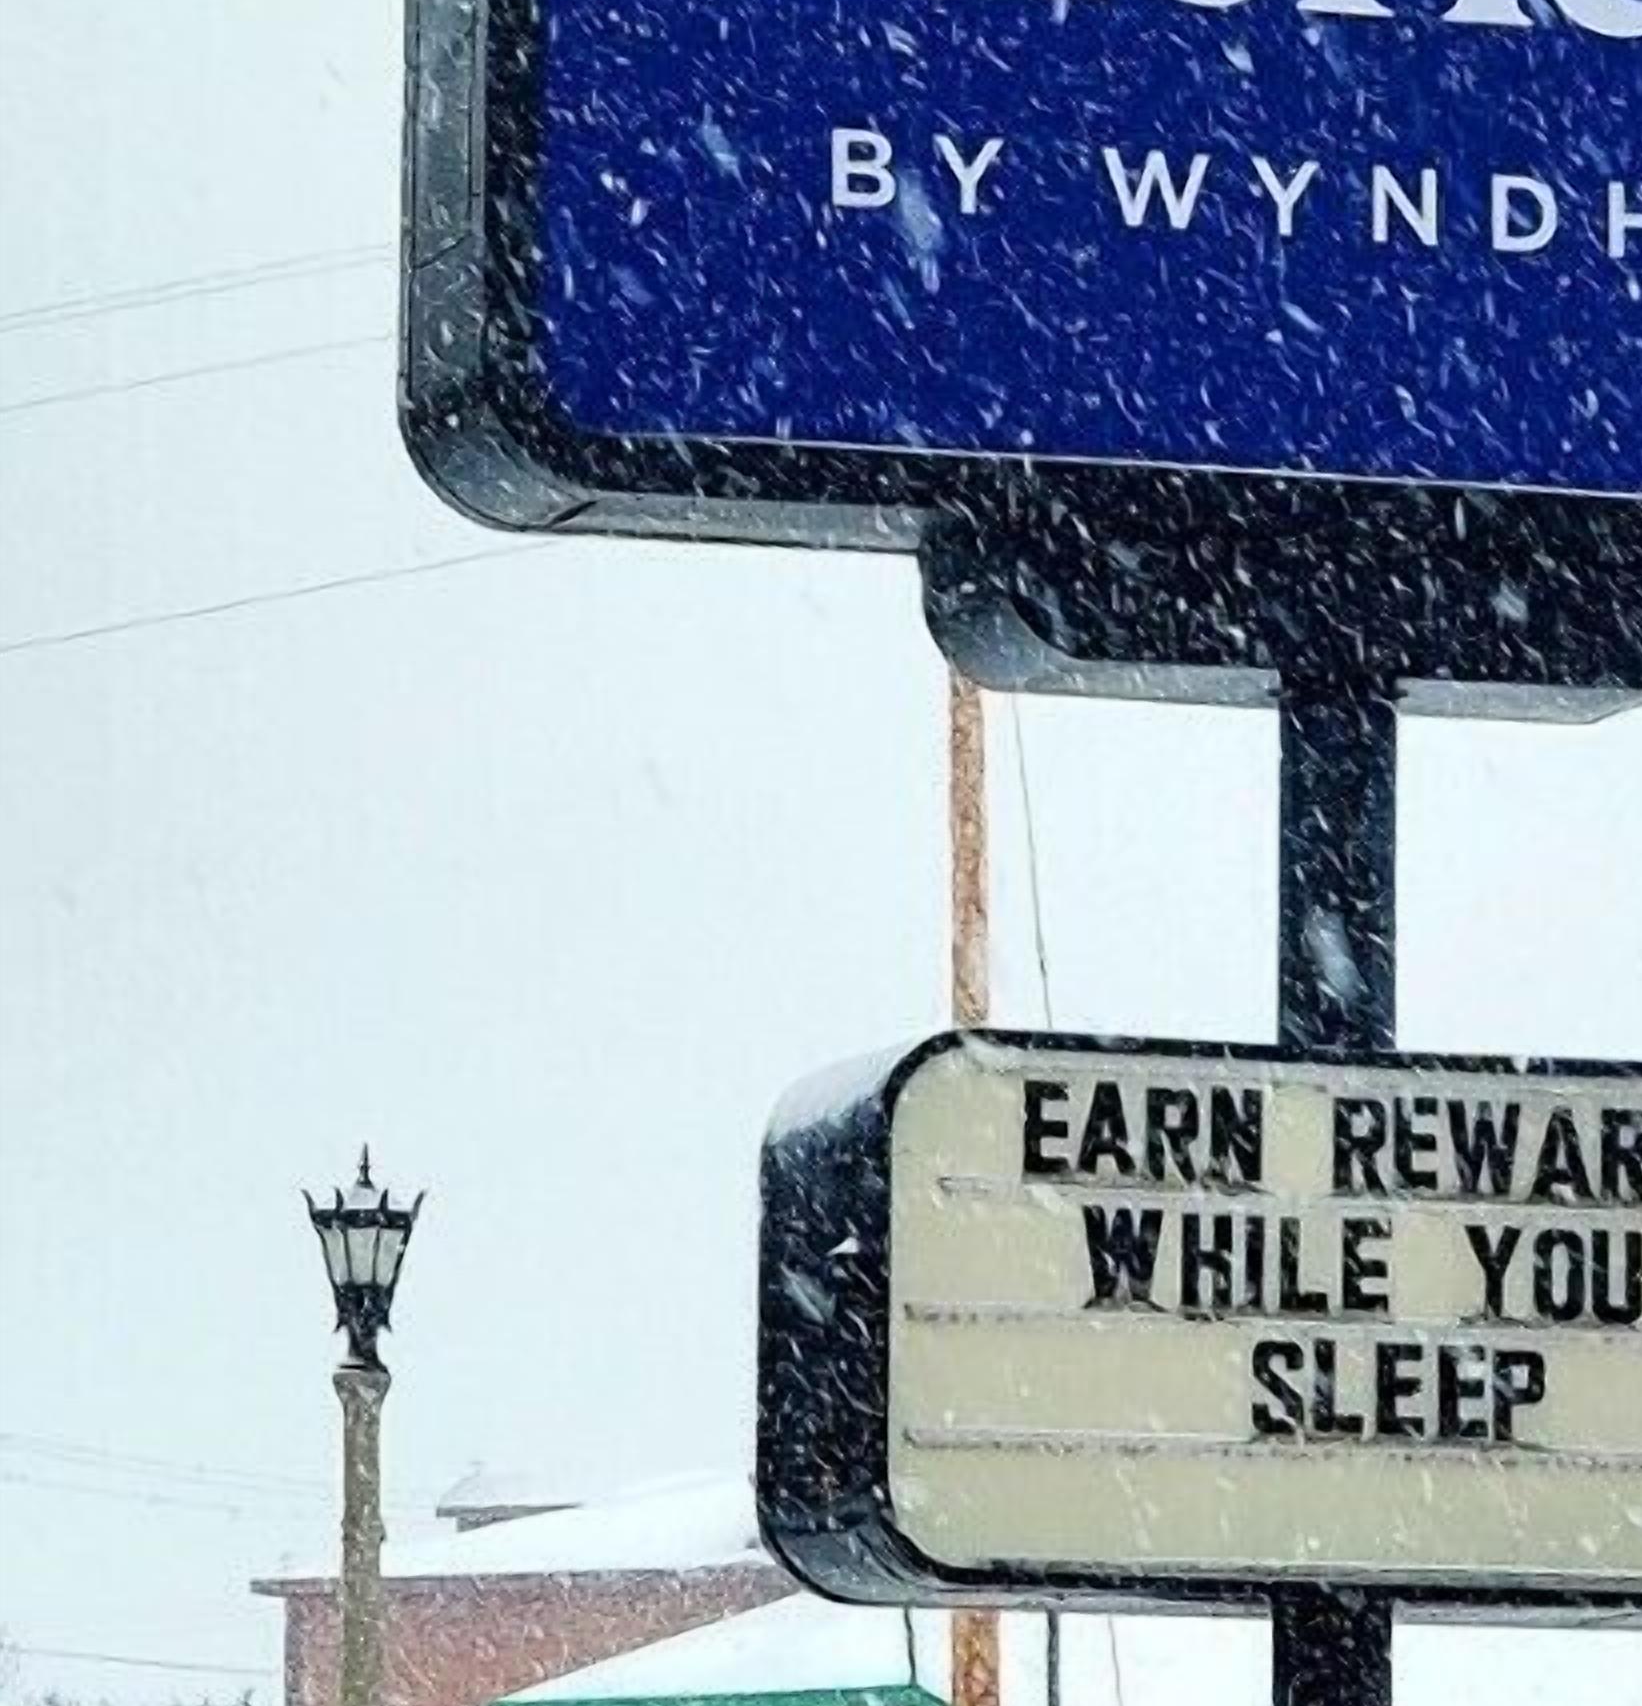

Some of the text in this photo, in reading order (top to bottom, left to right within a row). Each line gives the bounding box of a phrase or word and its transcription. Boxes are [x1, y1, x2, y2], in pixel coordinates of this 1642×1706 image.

[833, 129, 1003, 214] BY
[1023, 1080, 1263, 1186] EARN
[1082, 1205, 1393, 1312] WHILE
[1250, 1338, 1546, 1443] SLEEP
